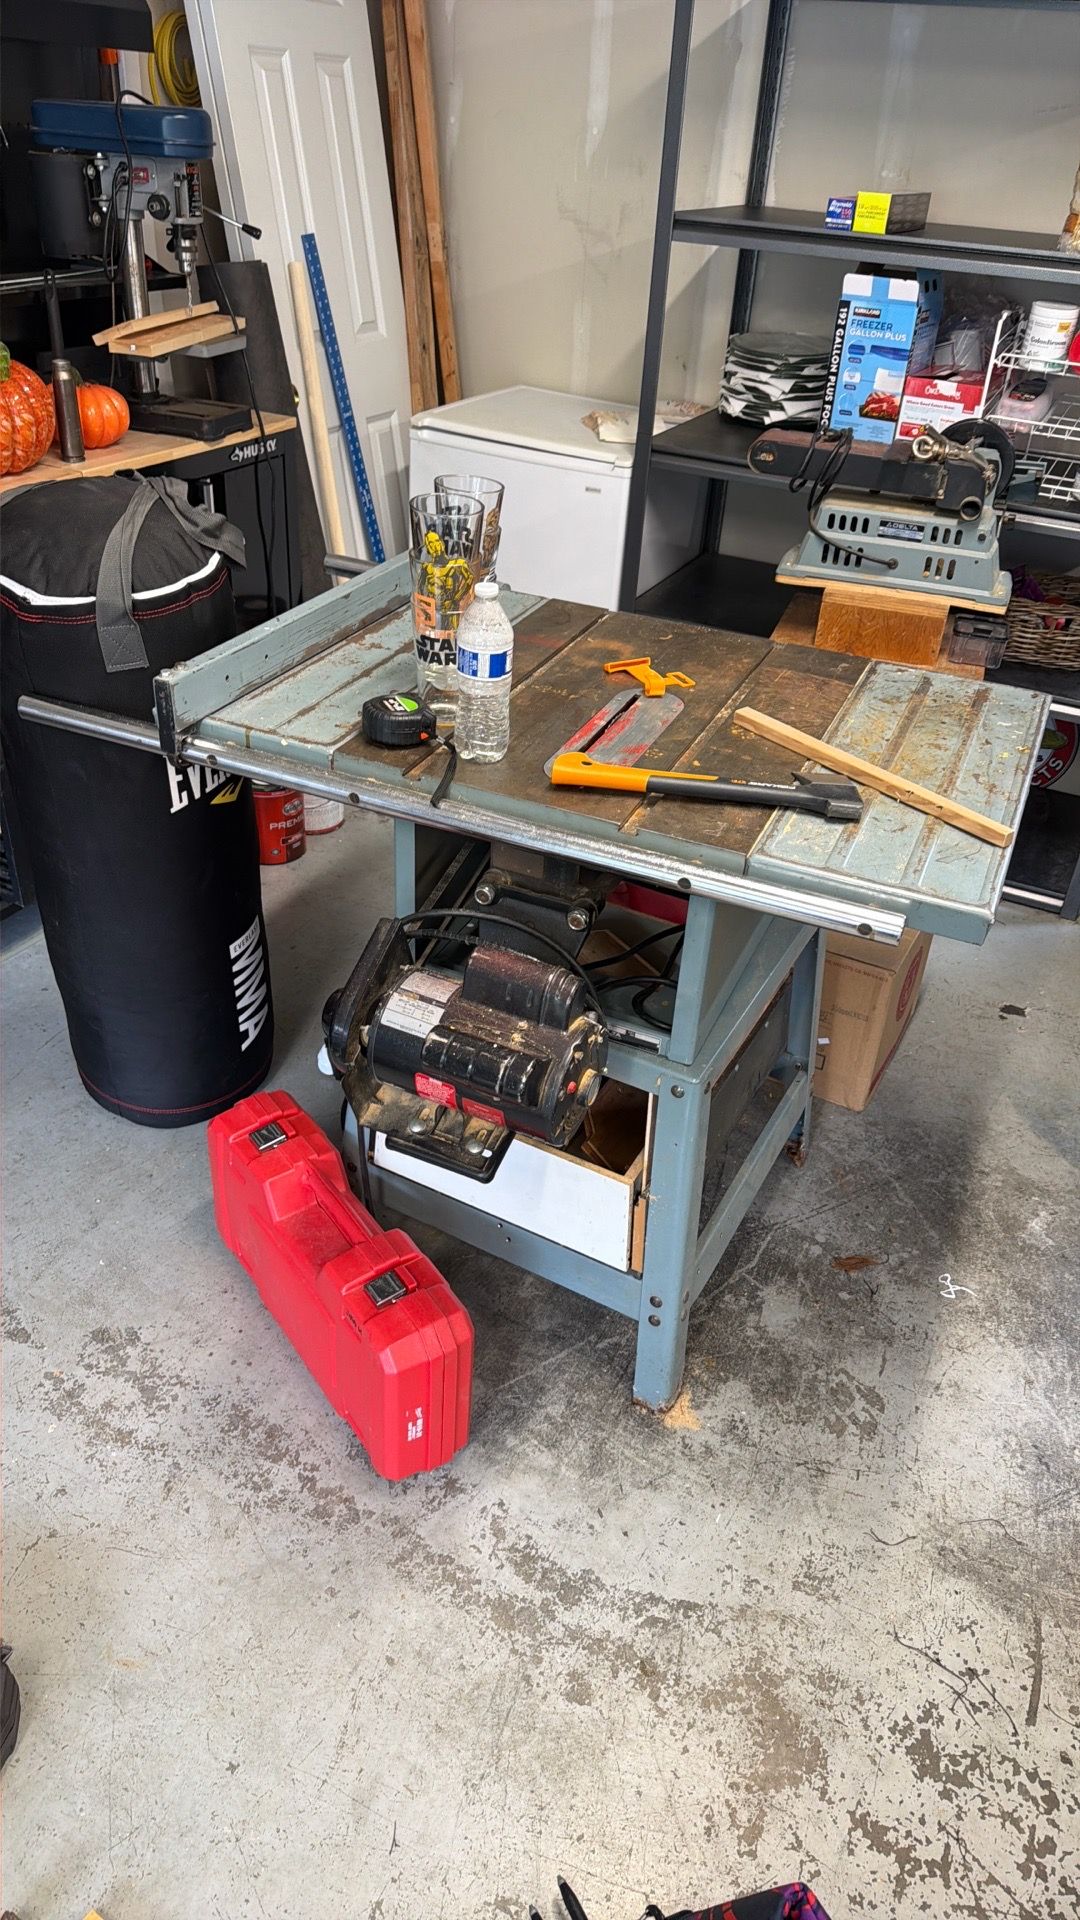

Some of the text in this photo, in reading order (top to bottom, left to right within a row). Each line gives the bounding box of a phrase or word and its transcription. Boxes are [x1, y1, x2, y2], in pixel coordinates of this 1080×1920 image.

[837, 307, 848, 325] 192
[850, 318, 894, 332] FREEZER
[849, 327, 907, 342] GALLON PLUS
[829, 329, 845, 373] GALLON
[824, 375, 837, 402] PLUS
[415, 634, 456, 652] STA
[415, 645, 457, 667] WAR
[233, 922, 259, 953] EVERLAST
